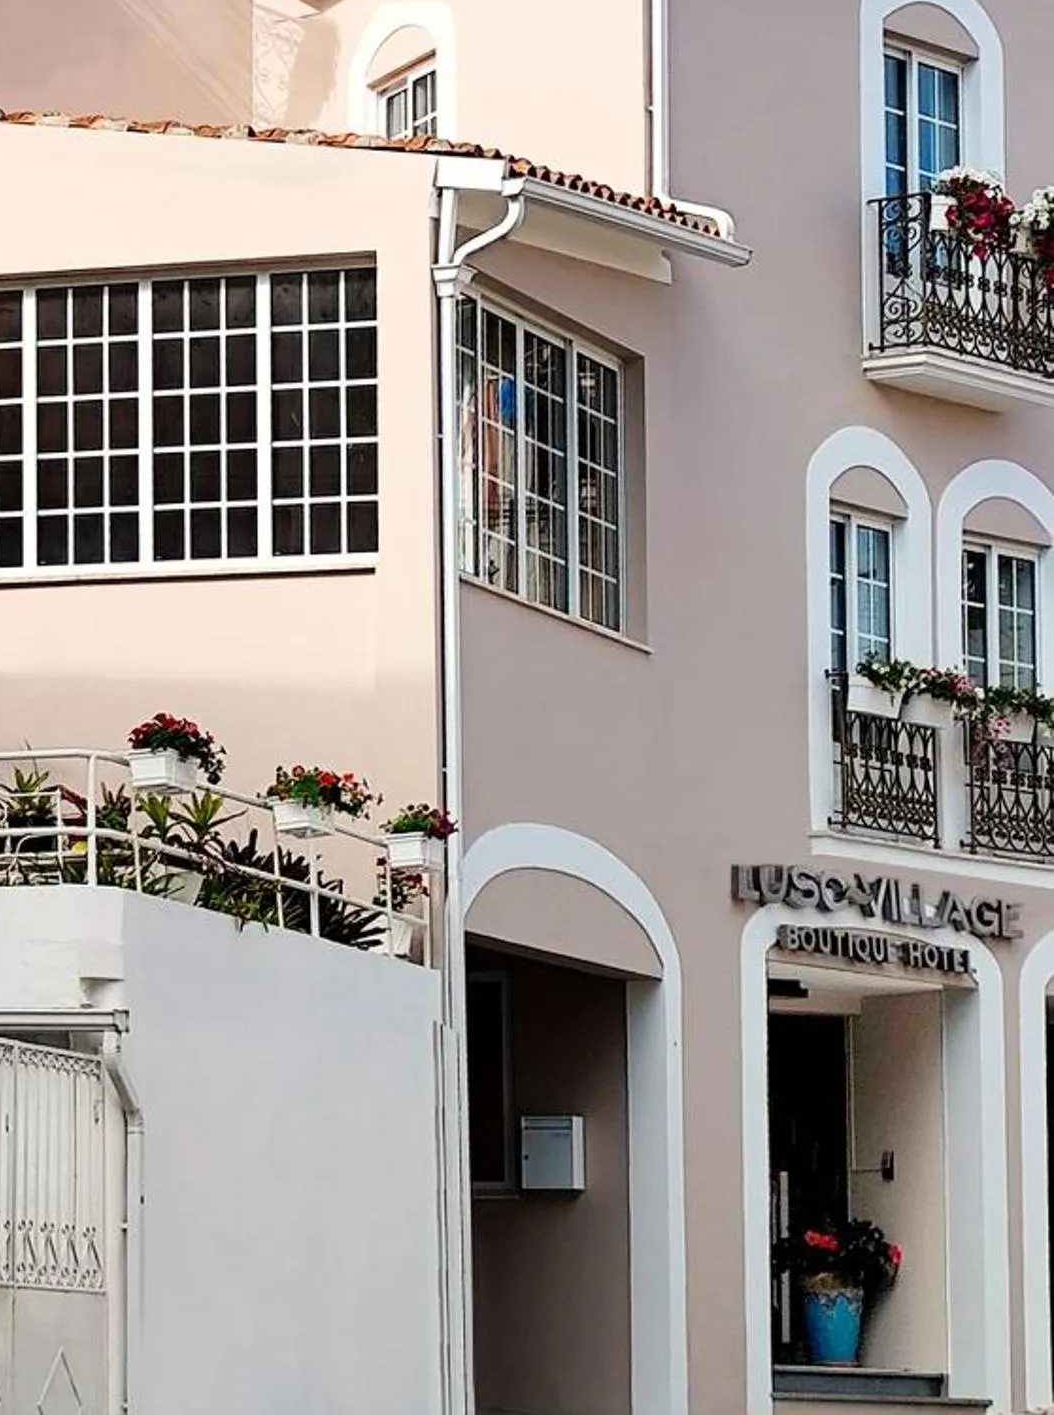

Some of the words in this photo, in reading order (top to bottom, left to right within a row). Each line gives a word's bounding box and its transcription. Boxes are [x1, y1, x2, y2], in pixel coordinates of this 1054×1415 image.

[731, 863, 849, 913] LUSO
[850, 873, 1024, 939] VILLAGE
[779, 924, 899, 963] BOUTIQUE
[906, 941, 977, 974] HOTEL
